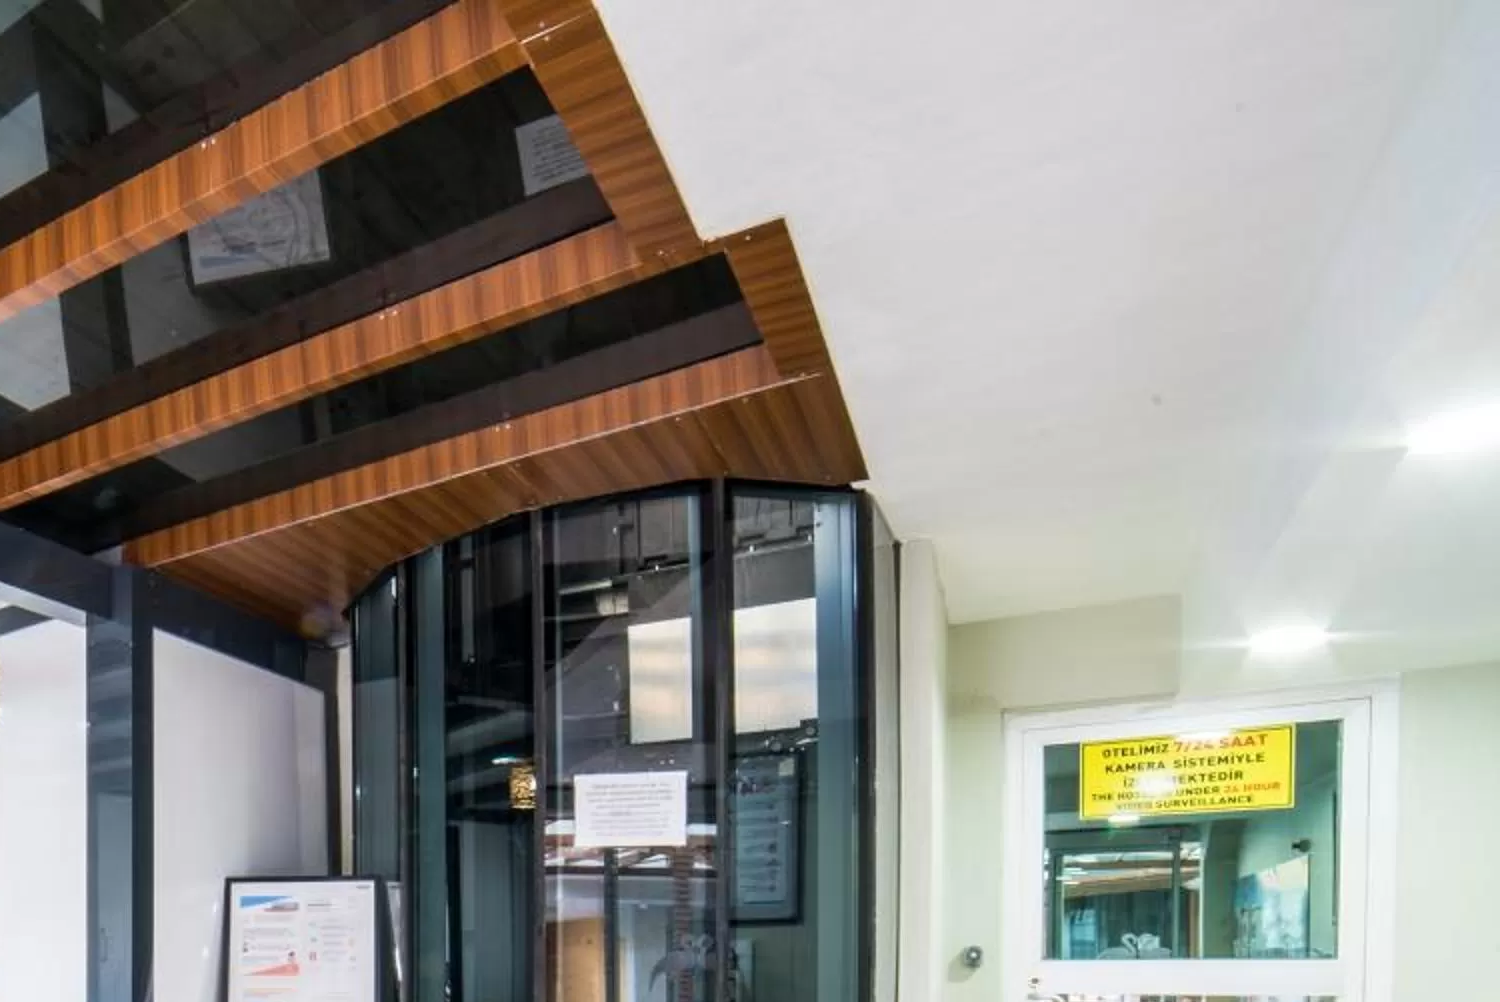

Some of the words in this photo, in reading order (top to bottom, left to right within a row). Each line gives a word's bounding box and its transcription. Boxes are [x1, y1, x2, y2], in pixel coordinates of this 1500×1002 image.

[1102, 743, 1169, 758] OTELİMİZ
[1220, 734, 1268, 748] SAAT
[1105, 760, 1165, 775] KAMERA
[1174, 752, 1265, 769] SİSTEMİYLE
[1123, 769, 1244, 788] İZEKTEDİR
[1092, 793, 1112, 801] THE
[1156, 795, 1252, 808] SURVEILLANCE
